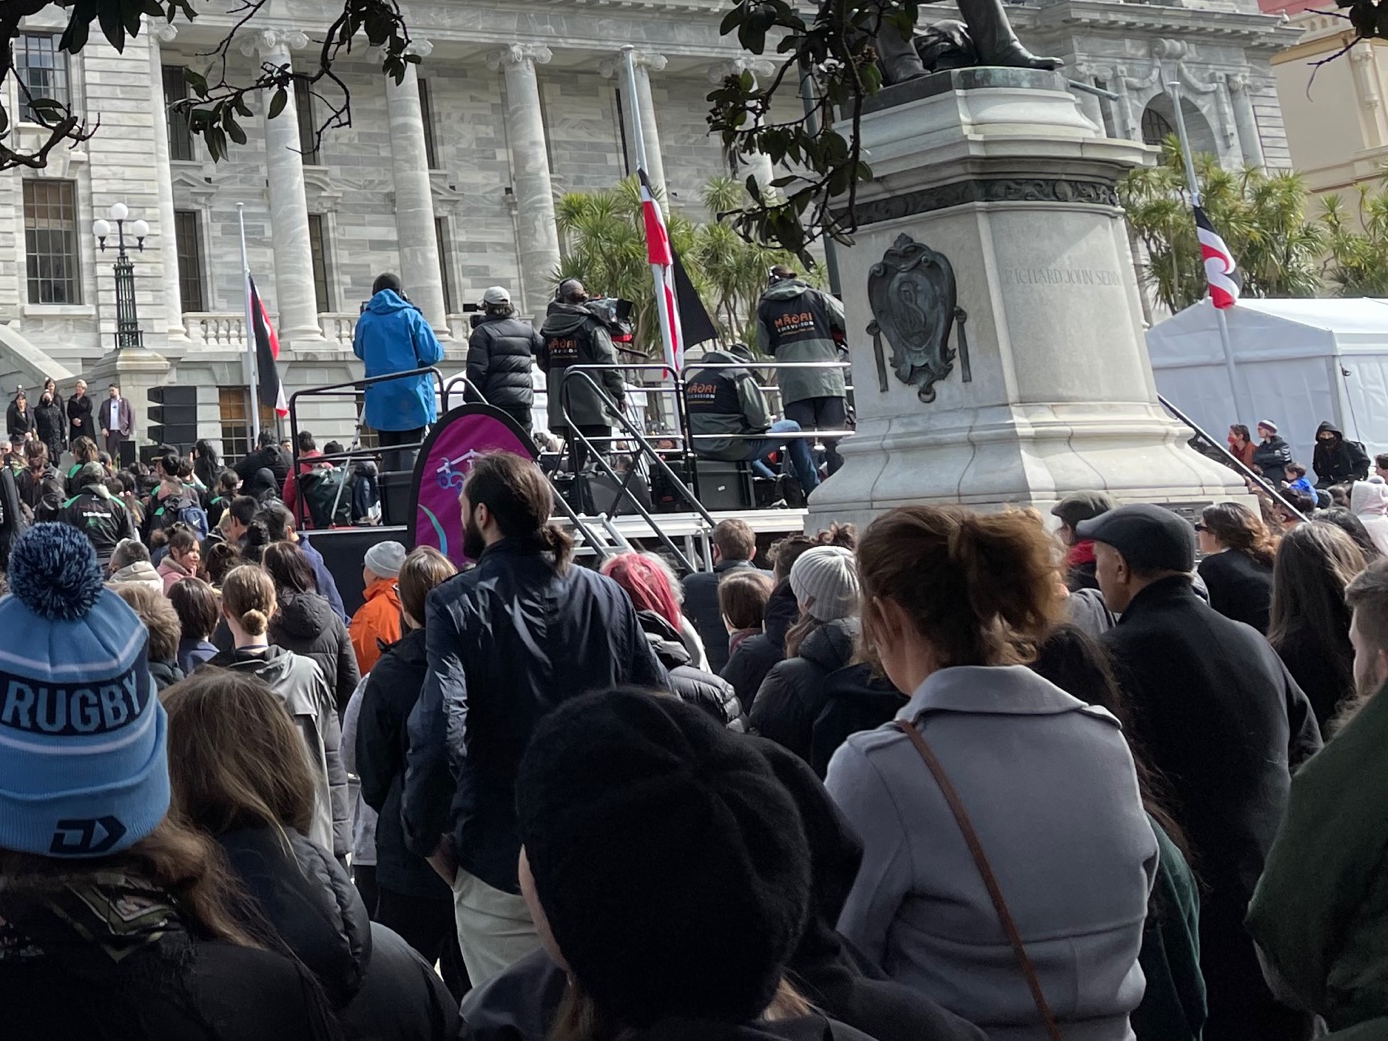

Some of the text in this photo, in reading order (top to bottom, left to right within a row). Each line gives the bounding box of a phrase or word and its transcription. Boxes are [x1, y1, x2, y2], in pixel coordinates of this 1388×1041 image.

[1004, 268, 1062, 285] RICHARD
[1066, 269, 1093, 285] JOHN
[0, 669, 141, 733] RUGBY
